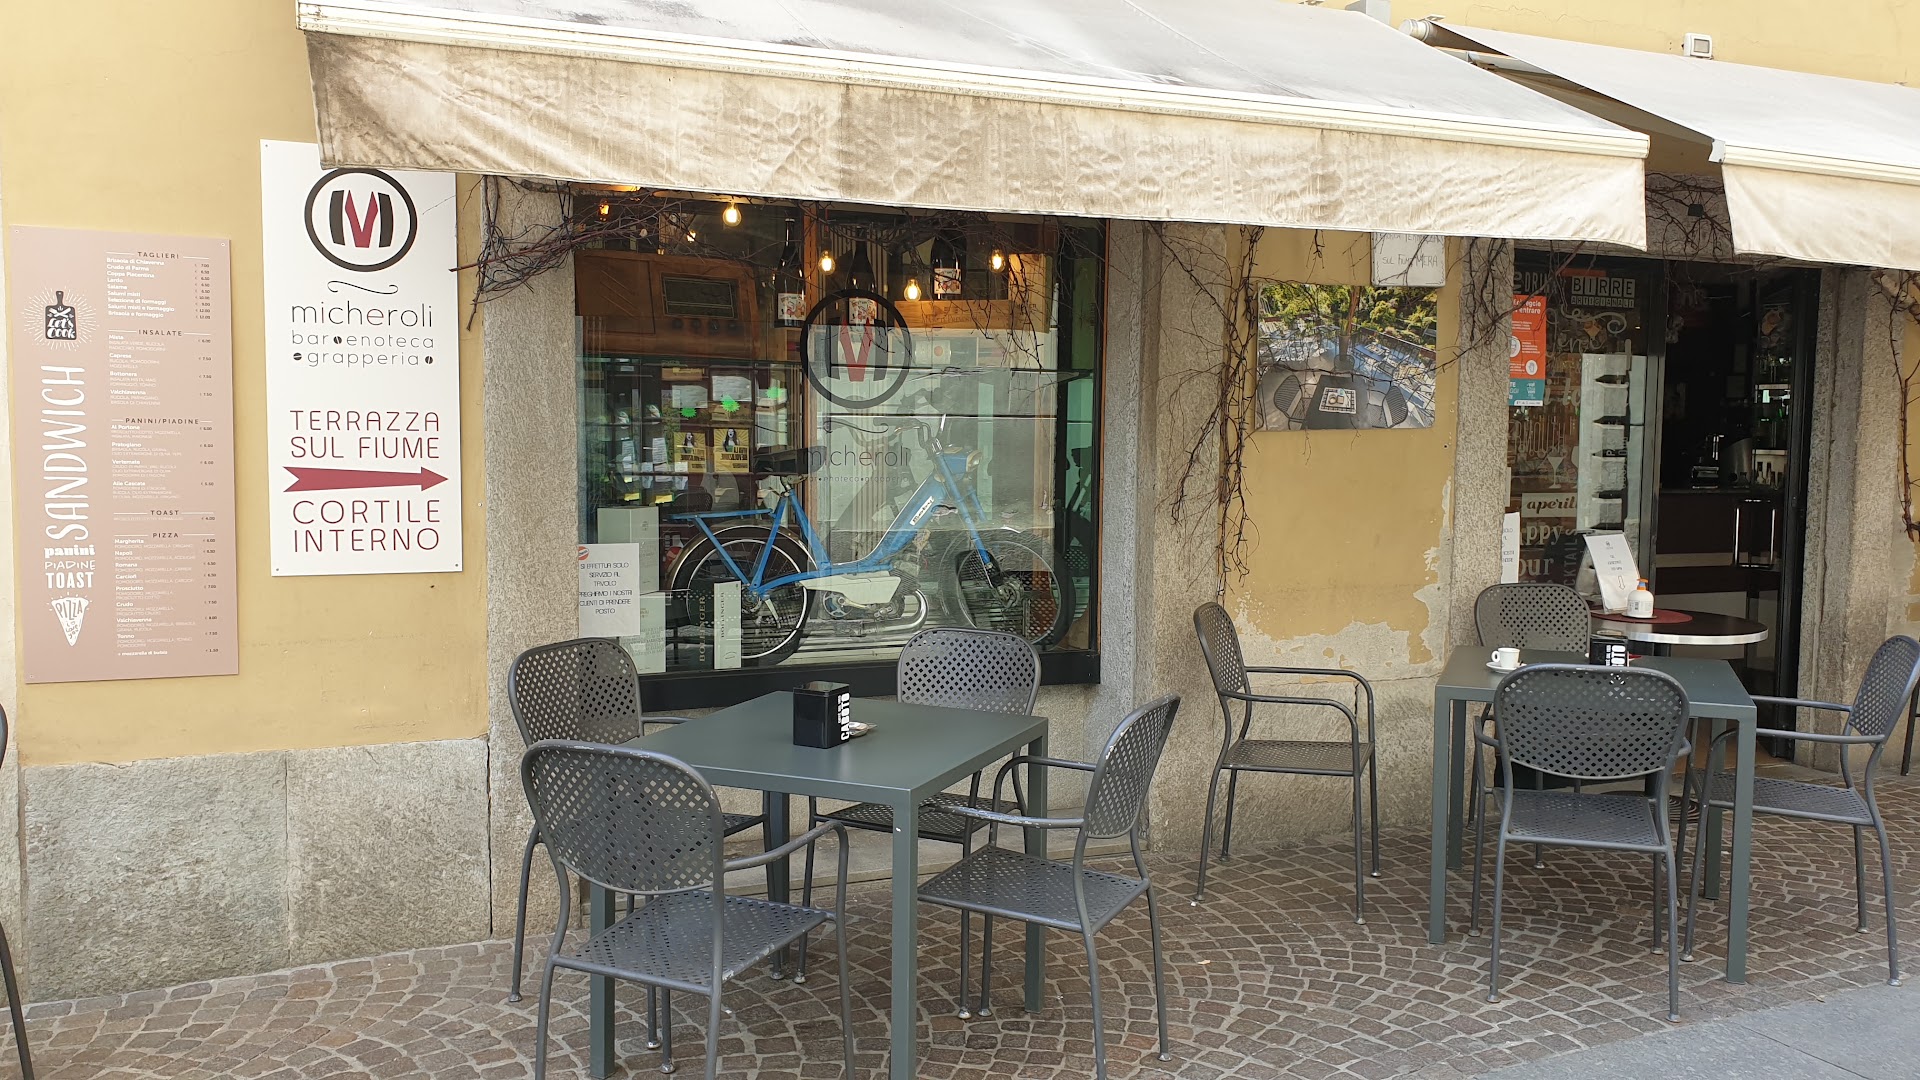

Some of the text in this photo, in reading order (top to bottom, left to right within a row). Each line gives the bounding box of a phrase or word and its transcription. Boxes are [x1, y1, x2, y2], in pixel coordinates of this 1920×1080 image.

[138, 251, 179, 259] TAGLIERI
[1572, 277, 1635, 298] BIRRE
[292, 300, 432, 327] micheroli
[47, 328, 75, 338] Cook
[292, 330, 434, 348] bar enoteca
[307, 352, 419, 368] grapperia
[290, 410, 439, 432] TERRAZZA
[41, 365, 89, 541] SANDWICH
[291, 436, 439, 459] SUL FIUME
[293, 500, 440, 524] CORTILE
[295, 528, 439, 552] INTERNO
[1520, 524, 1563, 545] ppy
[44, 545, 95, 559] panini
[45, 560, 95, 570] PIADINE
[45, 572, 94, 588] TOAST
[55, 599, 83, 620] PIZZA
